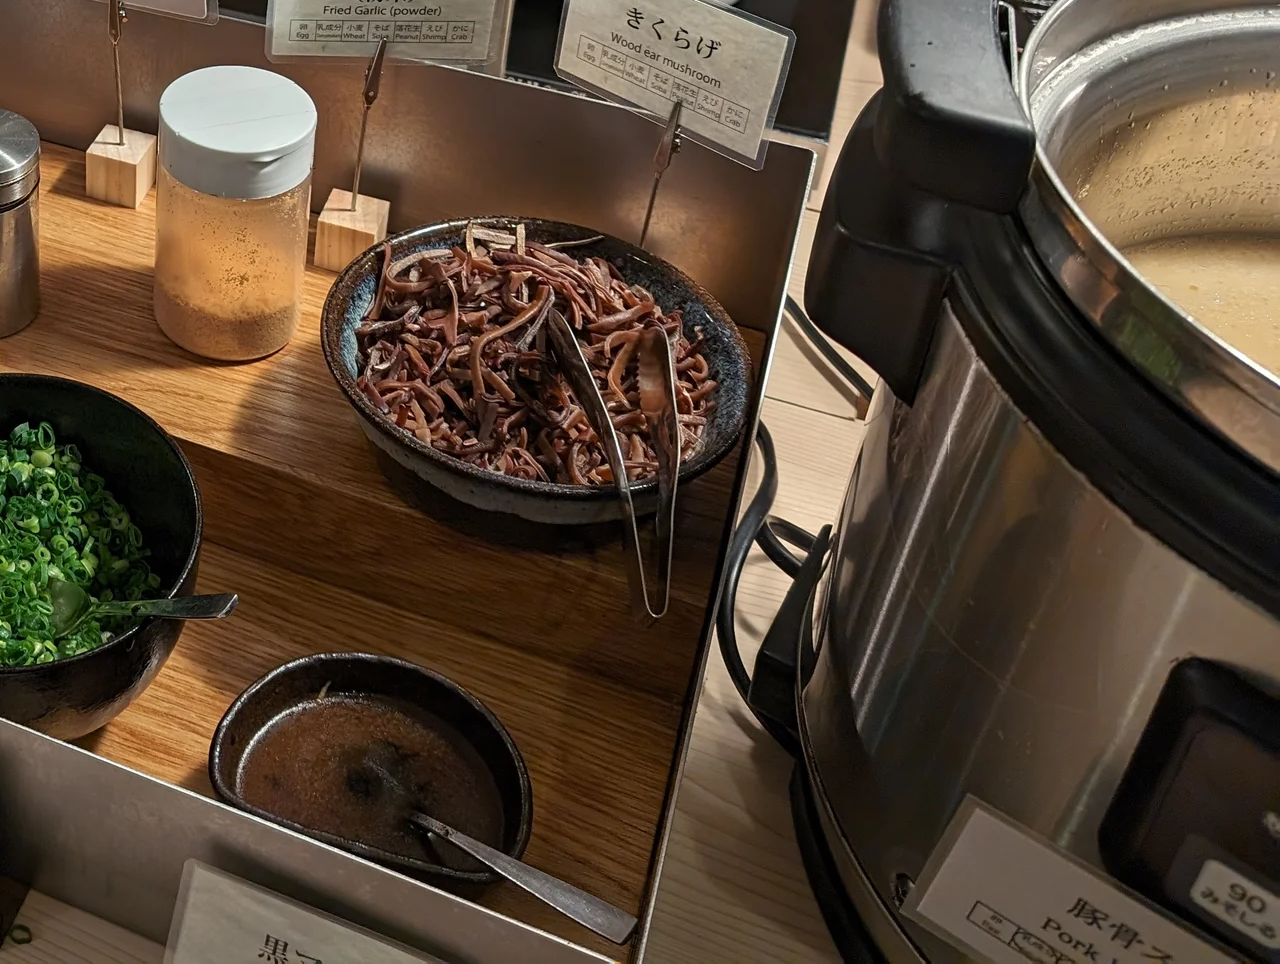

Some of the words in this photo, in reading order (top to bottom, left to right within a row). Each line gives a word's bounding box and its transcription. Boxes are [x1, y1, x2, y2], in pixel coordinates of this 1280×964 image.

[323, 5, 352, 16] Fried
[354, 5, 387, 16] Garlic
[389, 6, 442, 18] (powder)
[346, 24, 364, 32] 小麦
[373, 24, 390, 32] そば
[626, 7, 722, 59] きくらげ
[296, 32, 310, 40] Egg
[422, 33, 447, 41] Shrimp
[451, 33, 468, 41] Crab
[610, 31, 642, 54] Wood
[643, 48, 661, 62] ear
[662, 57, 721, 89] mushroom
[582, 51, 596, 63] Egg
[624, 70, 646, 84] Wheat
[651, 82, 668, 95] Soba
[696, 103, 721, 119] Shrimp
[724, 116, 741, 128] Crab
[629, 63, 645, 75] 小麦
[653, 72, 669, 83] そば
[701, 94, 719, 107] えび
[726, 106, 744, 119] かに
[1227, 882, 1268, 915] 90
[1040, 916, 1100, 962] Pork
